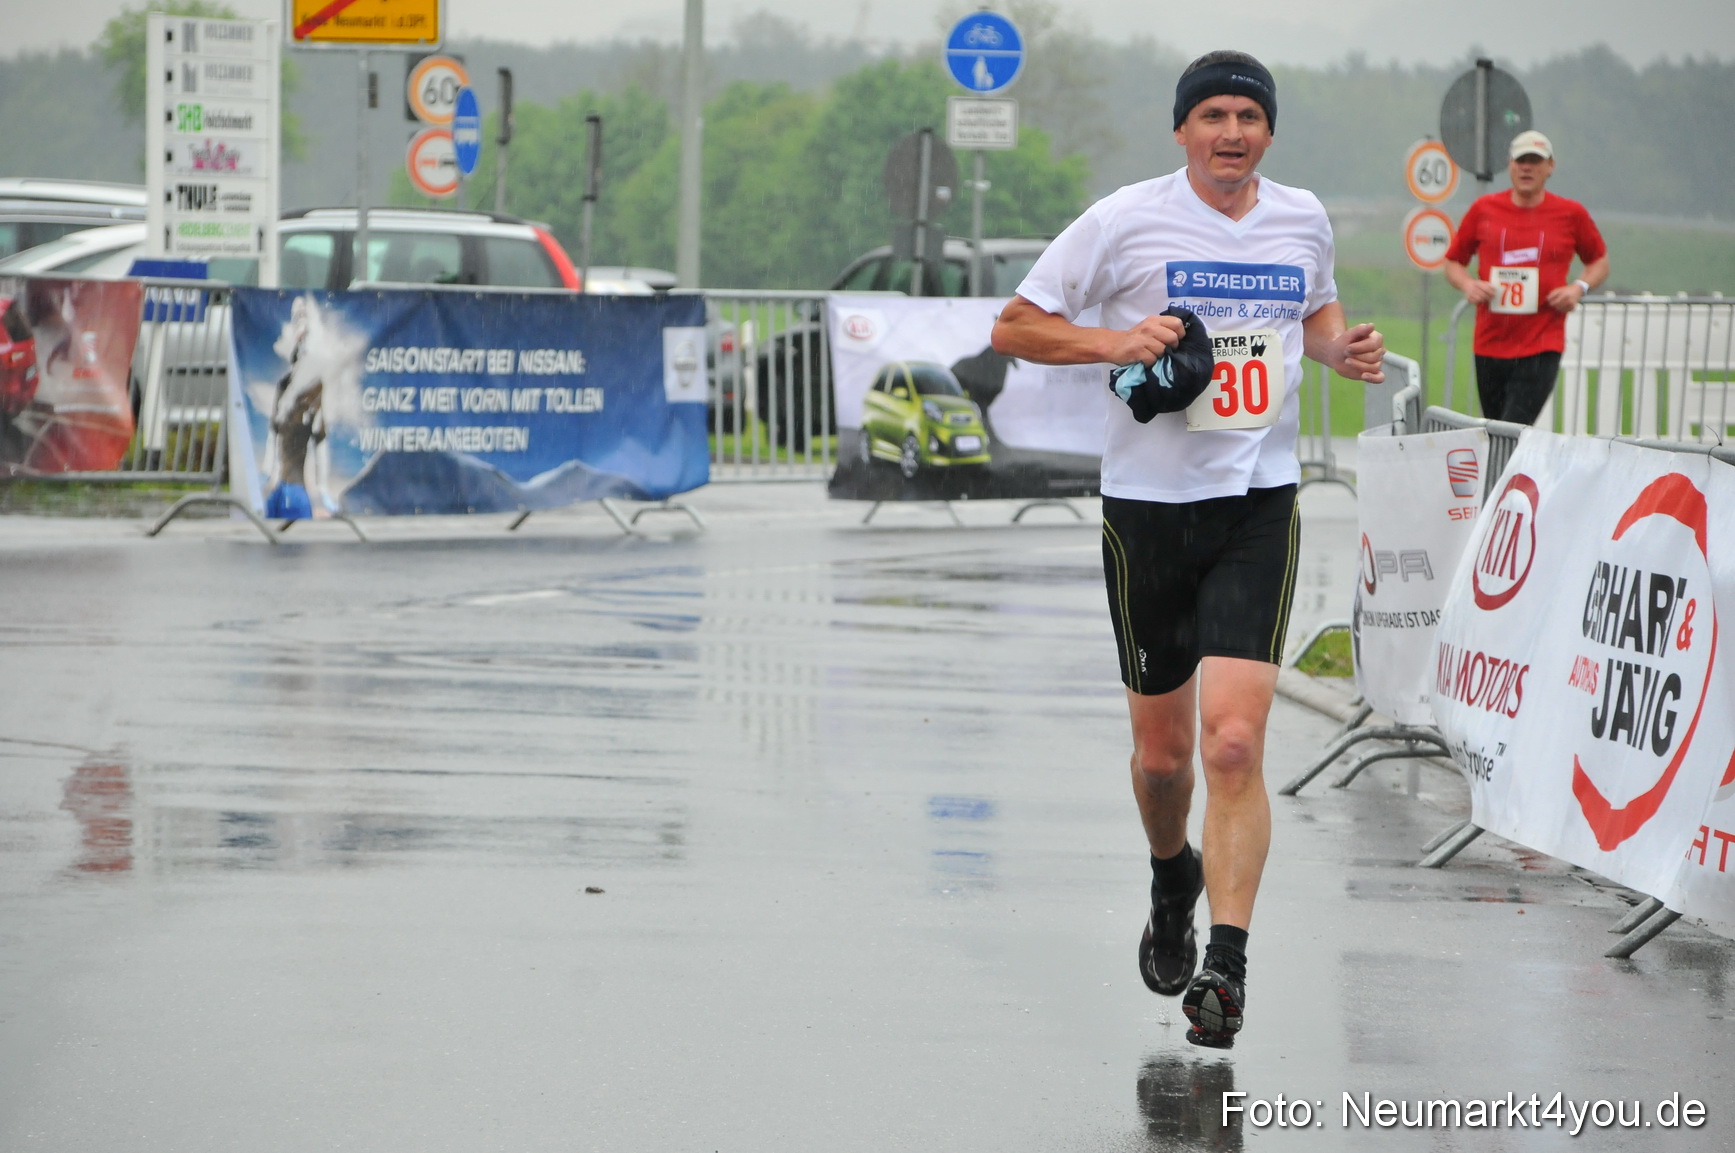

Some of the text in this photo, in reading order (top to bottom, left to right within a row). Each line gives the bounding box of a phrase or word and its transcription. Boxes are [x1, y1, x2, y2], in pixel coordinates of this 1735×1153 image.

[423, 76, 456, 105] 60
[1418, 159, 1447, 186] 60
[177, 183, 217, 211] THULE
[1192, 271, 1300, 293] STAEDTLER
[1499, 282, 1525, 307] 78
[1168, 301, 1302, 321] hreiben & Zeichnen
[364, 346, 586, 375] SAISONSTART BEI NISSAN:
[1211, 348, 1249, 358] ERBUNG
[361, 386, 605, 414] GANZ WET VORN MIT TOLLEN
[1211, 359, 1270, 418] 30
[360, 426, 530, 453] WINTERANGEBOTEN
[1480, 508, 1524, 581] KIA
[1403, 611, 1421, 628] IST
[1420, 609, 1442, 627] DAS
[1582, 560, 1697, 658] GRHART &
[1436, 641, 1530, 719] KIA MOTORS
